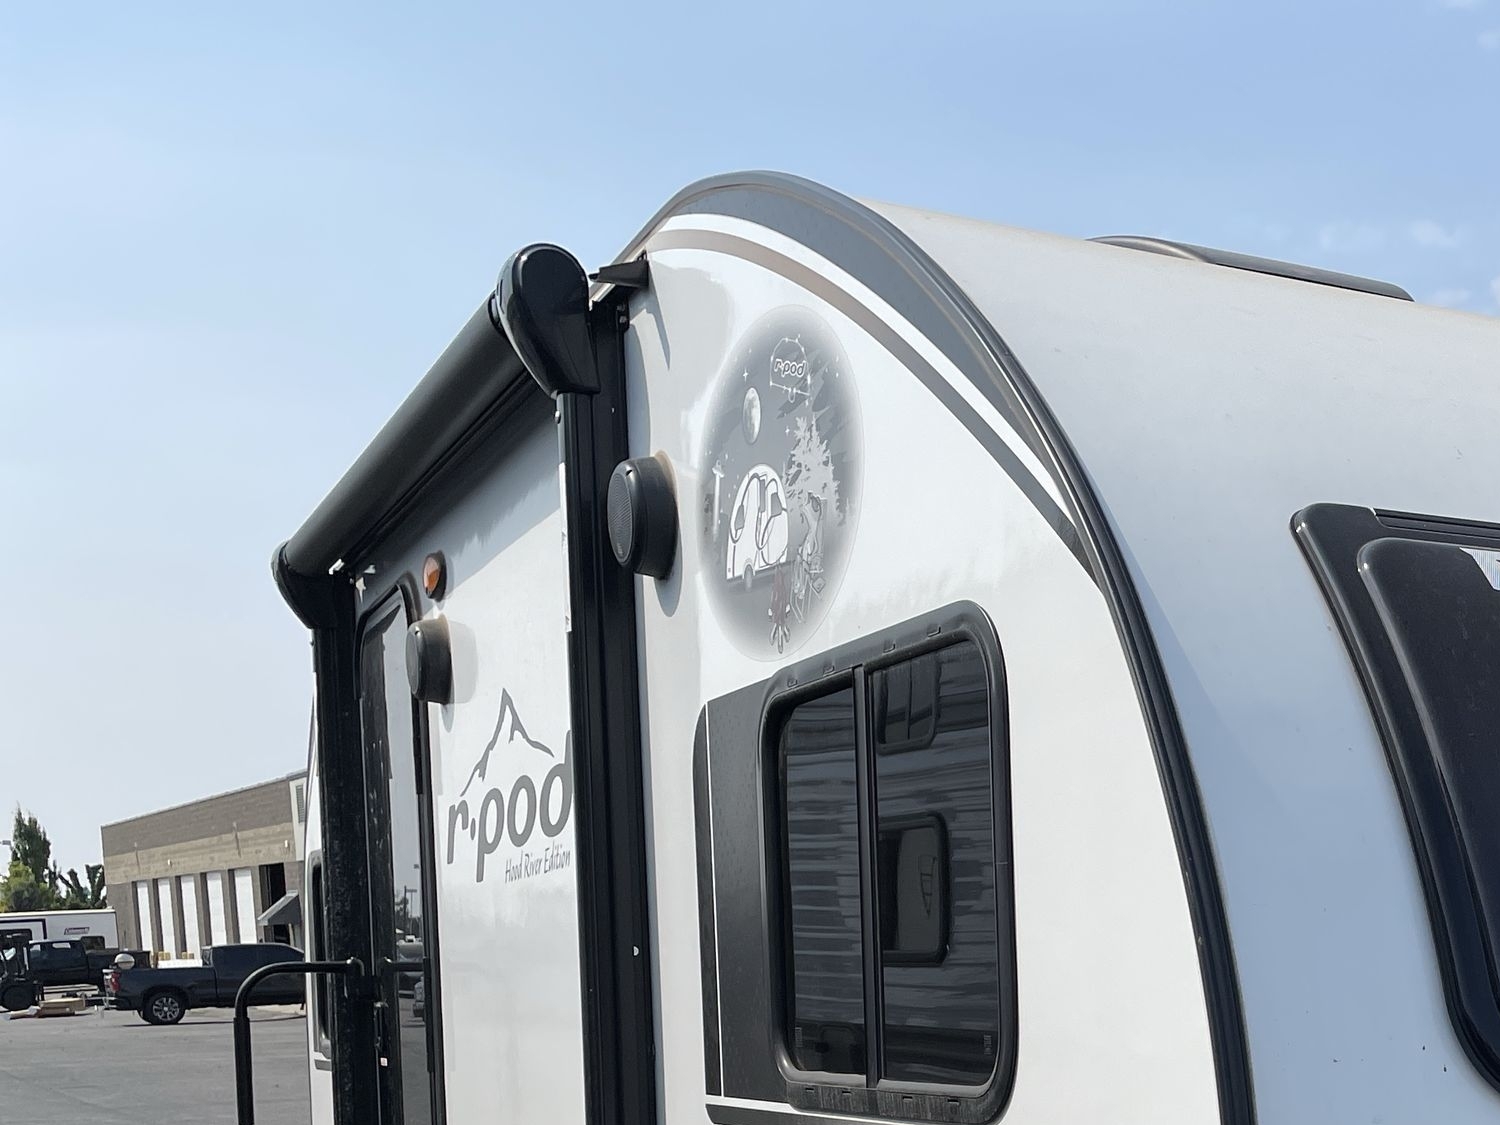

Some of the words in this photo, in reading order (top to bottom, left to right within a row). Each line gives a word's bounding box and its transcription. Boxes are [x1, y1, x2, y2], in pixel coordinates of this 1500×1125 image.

[505, 849, 523, 884] Hood
[524, 852, 543, 878] River
[544, 841, 571, 874] Edition
